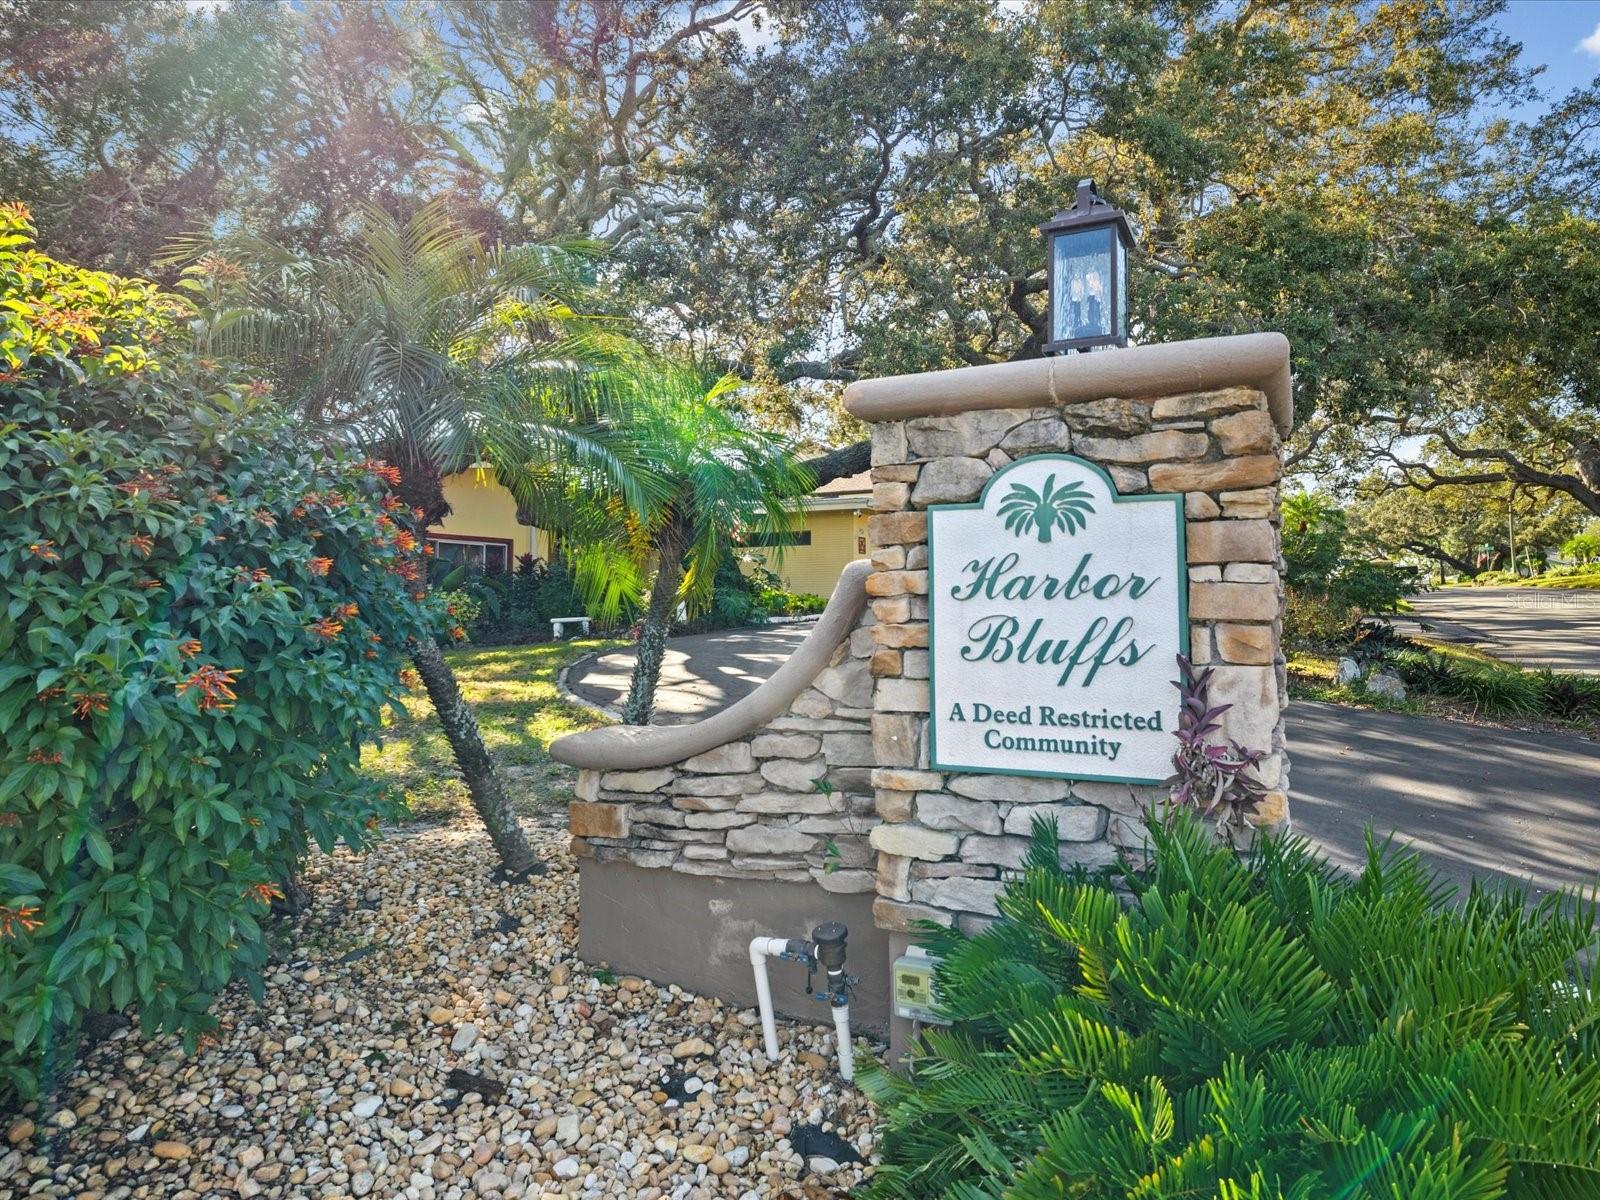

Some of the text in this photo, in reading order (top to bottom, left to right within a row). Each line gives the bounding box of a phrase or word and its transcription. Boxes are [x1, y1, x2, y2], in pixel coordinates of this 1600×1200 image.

[951, 553, 1160, 601] Harbor
[960, 615, 1156, 687] Bluffs
[949, 703, 1163, 731] A Deed Restricted
[984, 729, 1122, 760] Community
